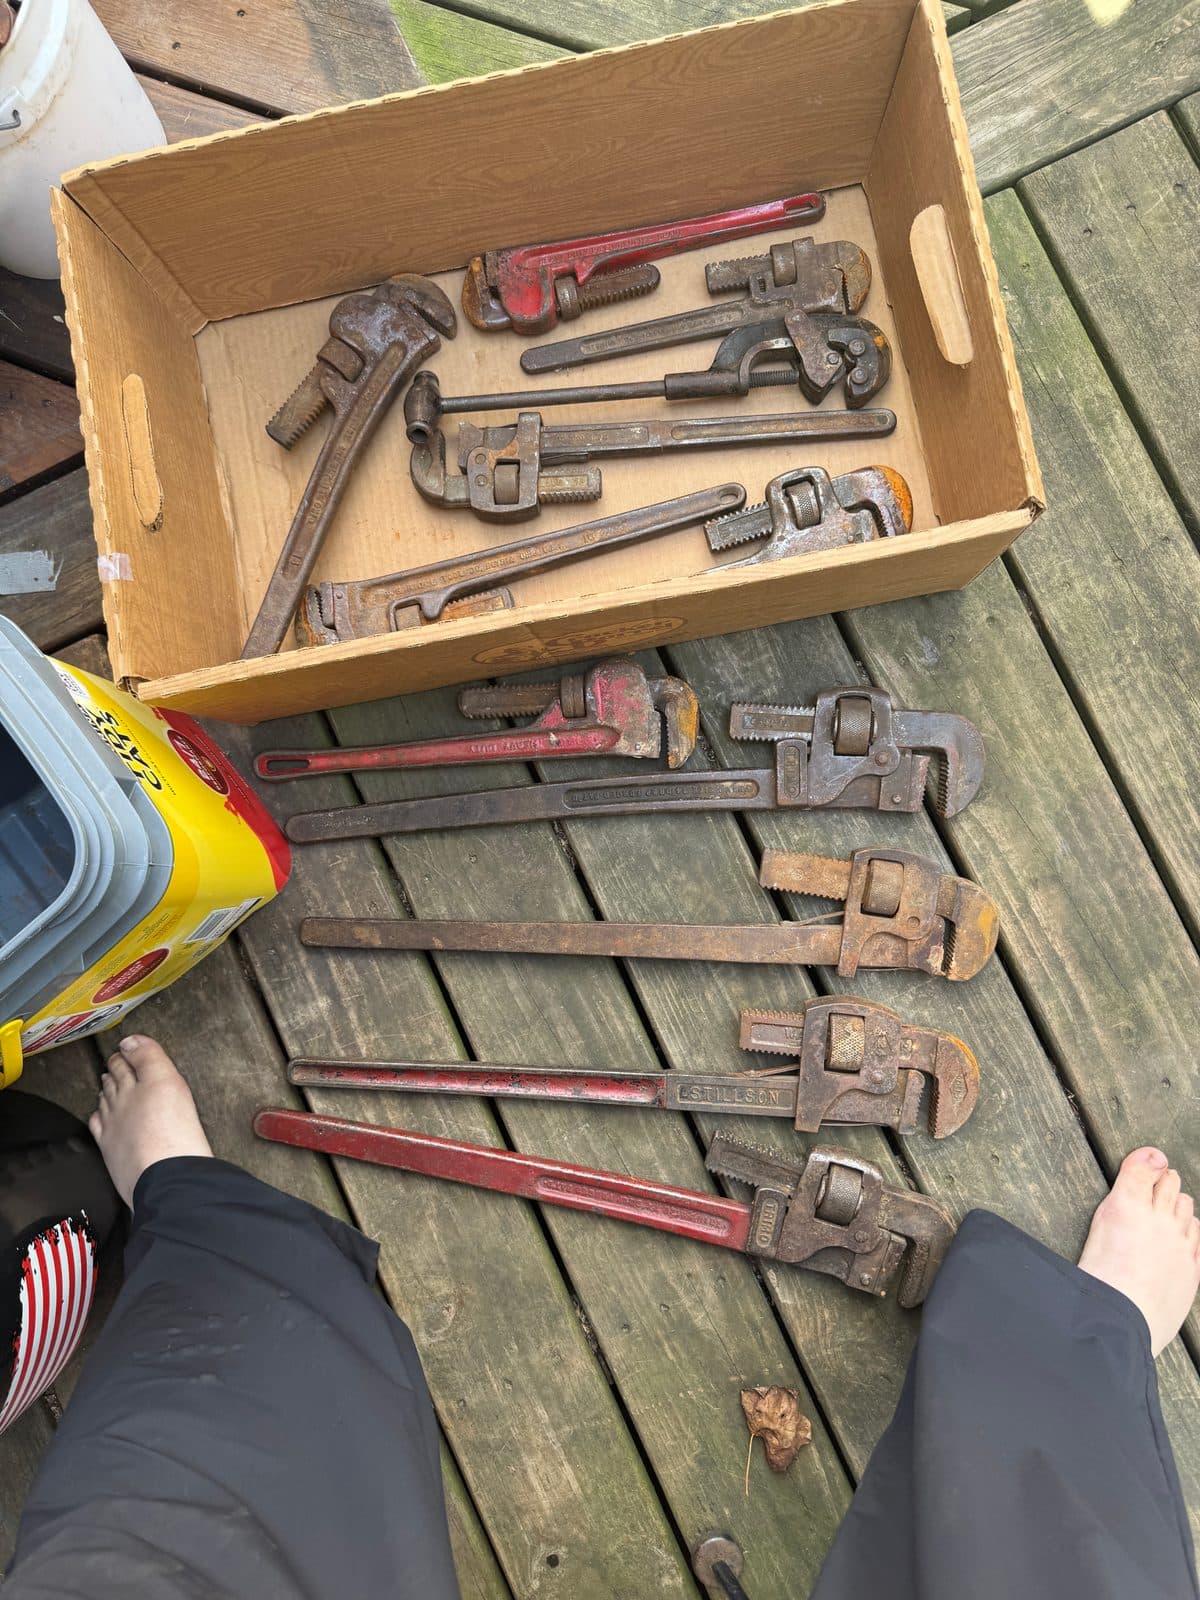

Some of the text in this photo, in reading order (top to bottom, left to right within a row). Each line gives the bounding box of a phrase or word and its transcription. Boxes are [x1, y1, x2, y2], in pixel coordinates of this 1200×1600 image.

[86, 707, 145, 778] TIDY
[99, 711, 162, 790] CATS
[690, 1085, 780, 1105] STILLSON
[760, 1203, 777, 1243] TRIMO
